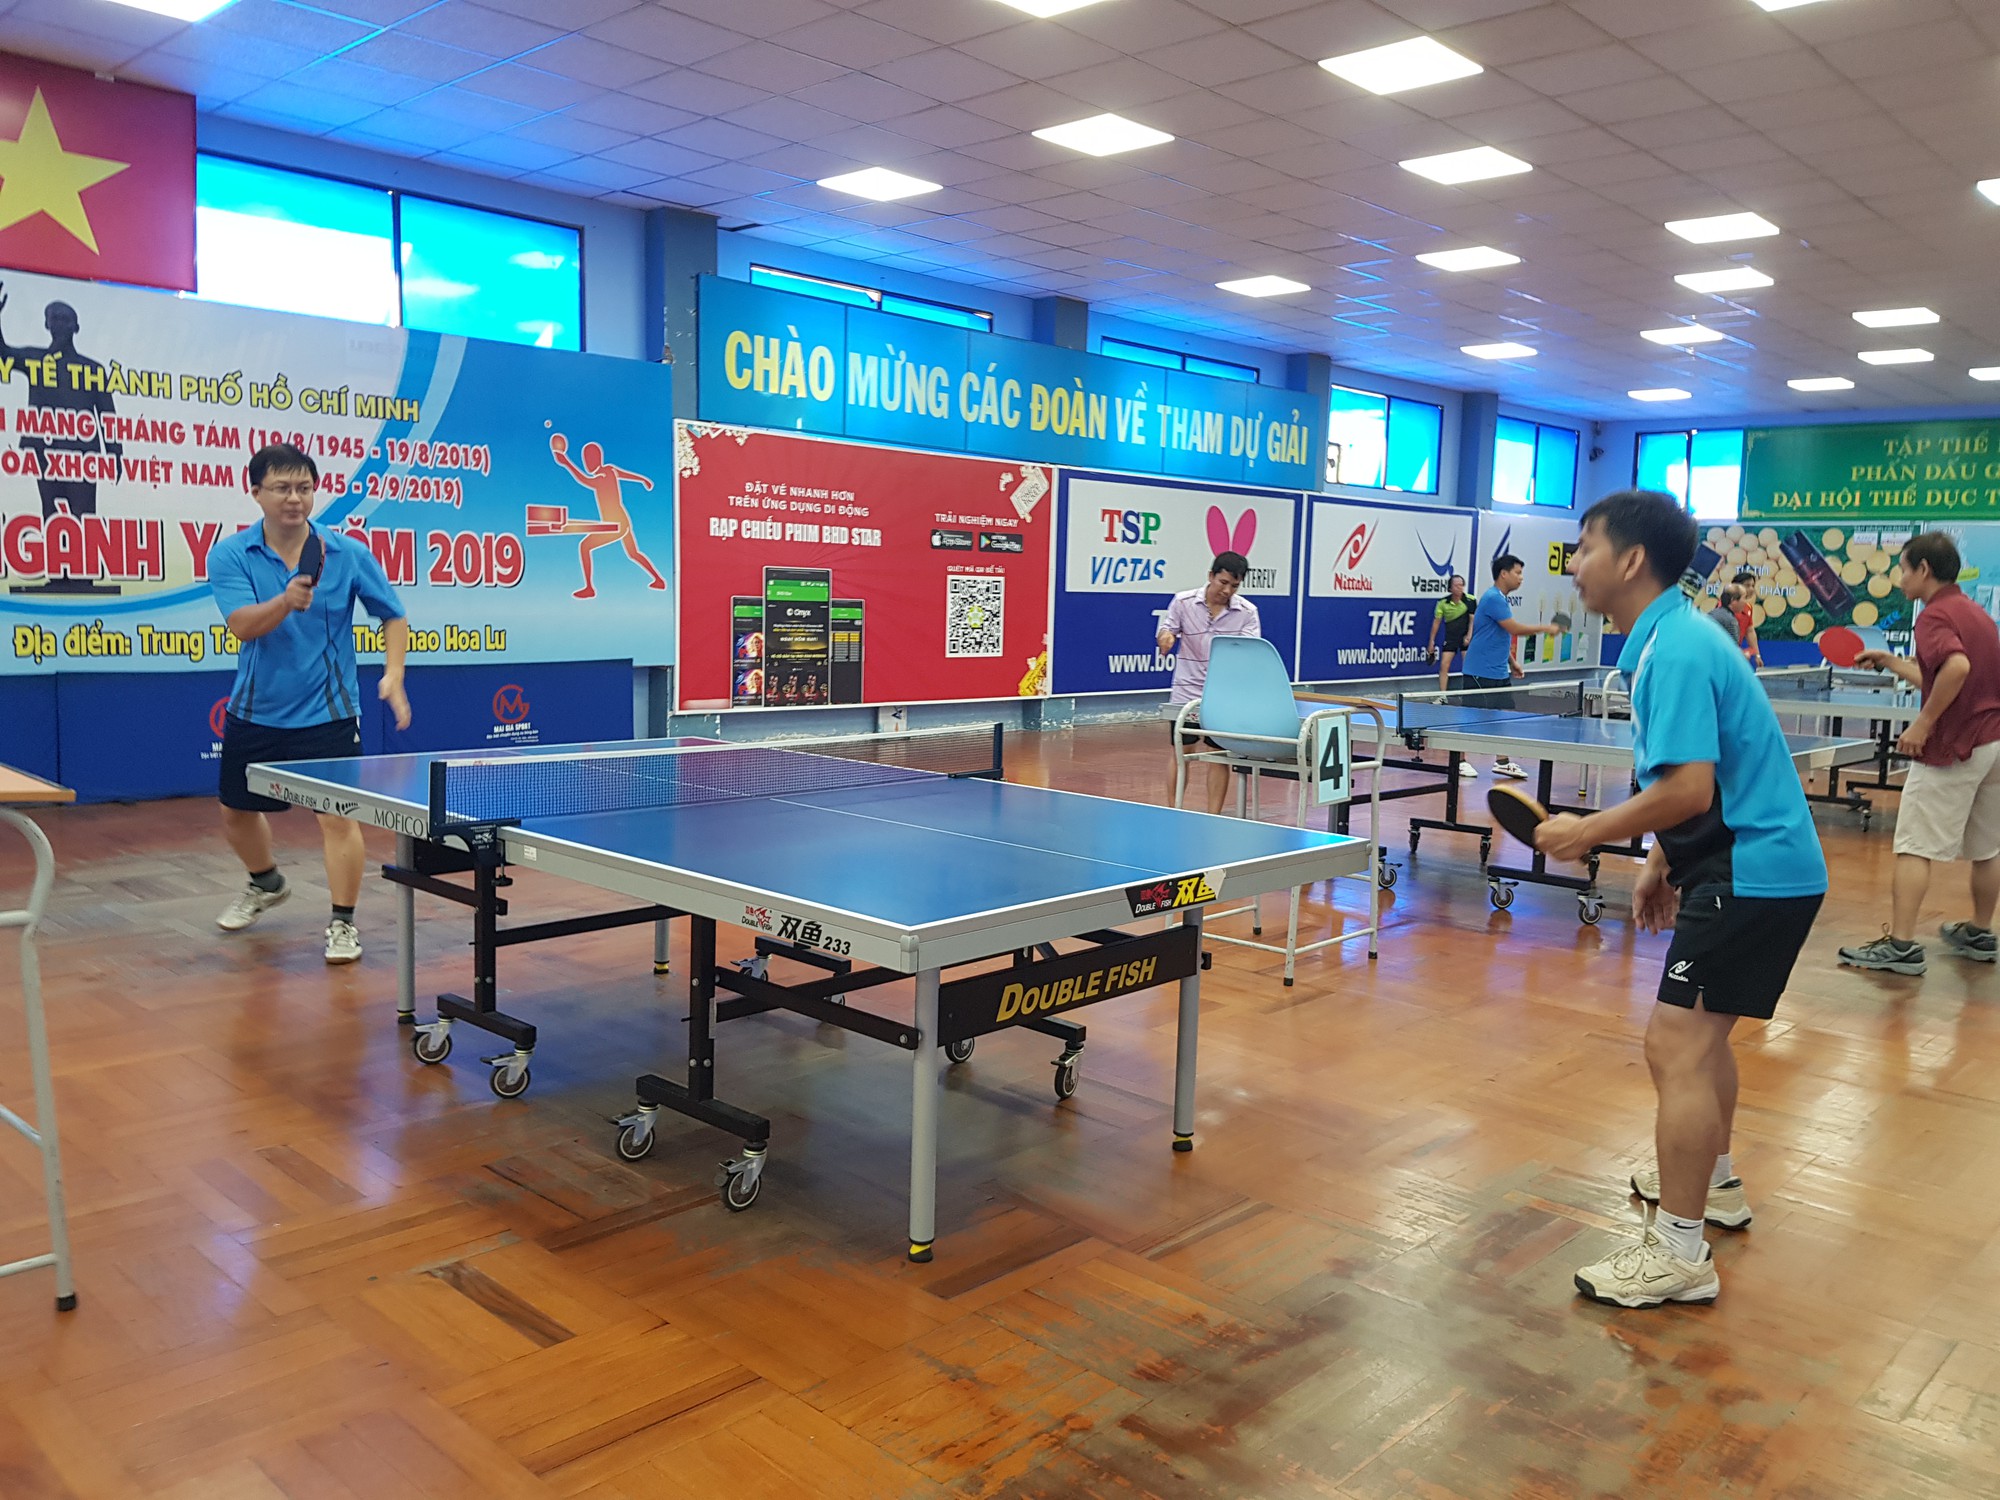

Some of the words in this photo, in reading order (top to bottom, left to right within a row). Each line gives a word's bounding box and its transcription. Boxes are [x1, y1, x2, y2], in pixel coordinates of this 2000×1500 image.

[0, 357, 15, 384] Y
[25, 351, 62, 388] TẾ
[67, 359, 172, 400] THÀNH
[180, 370, 244, 405] PHỐ
[250, 372, 293, 410] HỒ
[300, 384, 349, 416] CHÍ
[354, 394, 420, 423] MINH
[725, 325, 835, 402] CHÀO
[848, 343, 949, 419] MỪNG
[959, 363, 1021, 428] CÁC
[1030, 377, 1107, 440] ĐOÀN
[1115, 381, 1148, 445] VỀ
[1157, 404, 1223, 455] THAM
[1229, 411, 1263, 468] DỰ
[1267, 409, 1309, 465] GIẢI
[16, 408, 96, 443] MẠNG
[103, 413, 186, 446] THÁNG
[193, 419, 241, 450] TÁM
[387, 440, 491, 475] 19/8/2019)
[1884, 437, 1931, 459] TẬP
[1938, 429, 1989, 454] THỂ
[47, 453, 116, 481] XHCN
[123, 455, 173, 490] VIỆT
[181, 462, 234, 488] NAM
[1850, 457, 1917, 481] PHẤN
[367, 474, 462, 507] 2/9/2019)
[745, 481, 768, 496] ĐẶT
[790, 487, 828, 500] NHANH
[831, 490, 855, 502] HƠN
[1772, 490, 1813, 511] ĐẠI
[1819, 486, 1861, 510] HỘI
[1869, 482, 1917, 507] THỂ
[1924, 488, 1977, 510] DỤC
[728, 495, 758, 509] TRÊN
[762, 496, 787, 510] ỨNG
[790, 501, 822, 514] DỤNG
[824, 504, 836, 515] DI
[838, 504, 869, 518] ĐỘNG
[709, 517, 738, 541] RẠP
[741, 515, 782, 541] CHIẾU
[785, 523, 819, 543] PHIM
[822, 526, 849, 544] BHD
[851, 528, 882, 547] STAR
[995, 517, 1018, 528] NGAY
[1101, 508, 1161, 545] TSP
[0, 499, 163, 580] GÀNH
[179, 521, 220, 578] Y
[428, 530, 525, 588] 2019
[1090, 556, 1166, 585] VICTAS
[1333, 573, 1373, 591] Nittaku
[1368, 610, 1417, 636] TAKE
[14, 625, 57, 665] Địa
[64, 619, 132, 657] điểm:
[137, 625, 205, 663] Trung
[444, 625, 481, 652] Hoa
[1337, 642, 1440, 669] www.bongban.aa
[1319, 726, 1344, 790] 4
[374, 808, 424, 838] MOFICO
[1135, 902, 1156, 914] DOUBLE
[1160, 898, 1172, 908] FISH
[777, 914, 822, 947] 双鱼
[823, 936, 851, 956] 233
[996, 969, 1103, 1022] DOUBLE
[1104, 956, 1157, 993] FISH
